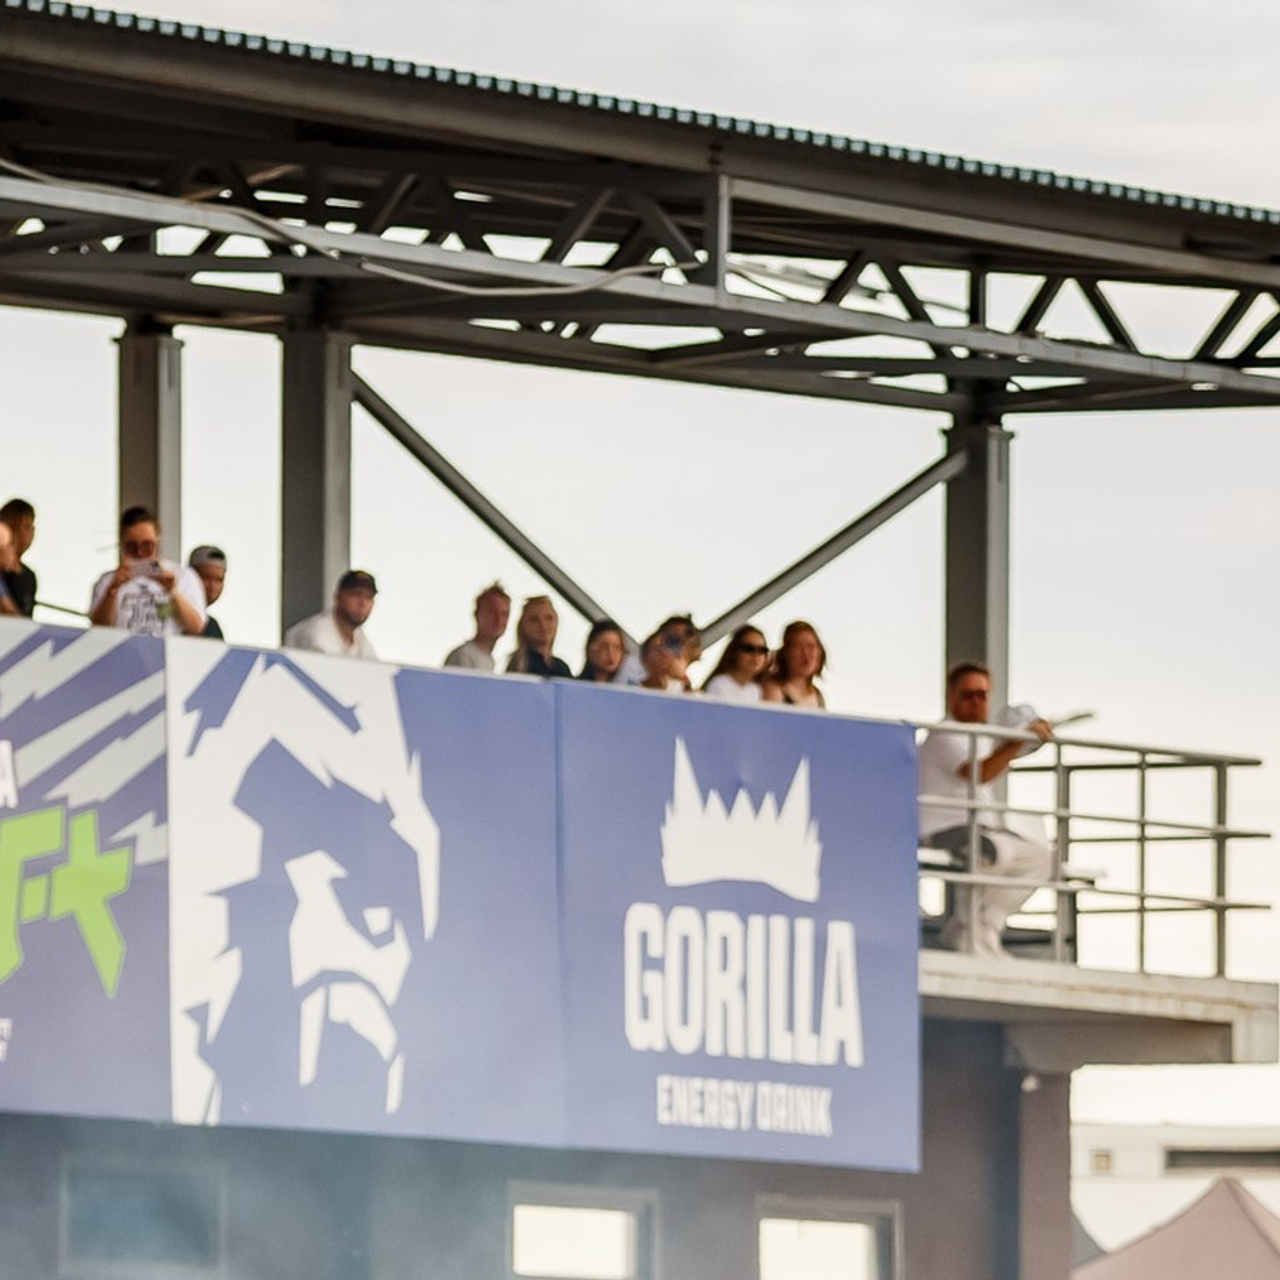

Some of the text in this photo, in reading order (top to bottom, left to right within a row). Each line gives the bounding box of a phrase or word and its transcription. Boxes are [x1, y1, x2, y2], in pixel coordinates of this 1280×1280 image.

[624, 901, 864, 1068] GORILLA
[656, 1073, 833, 1138] ENERGY DRINK
